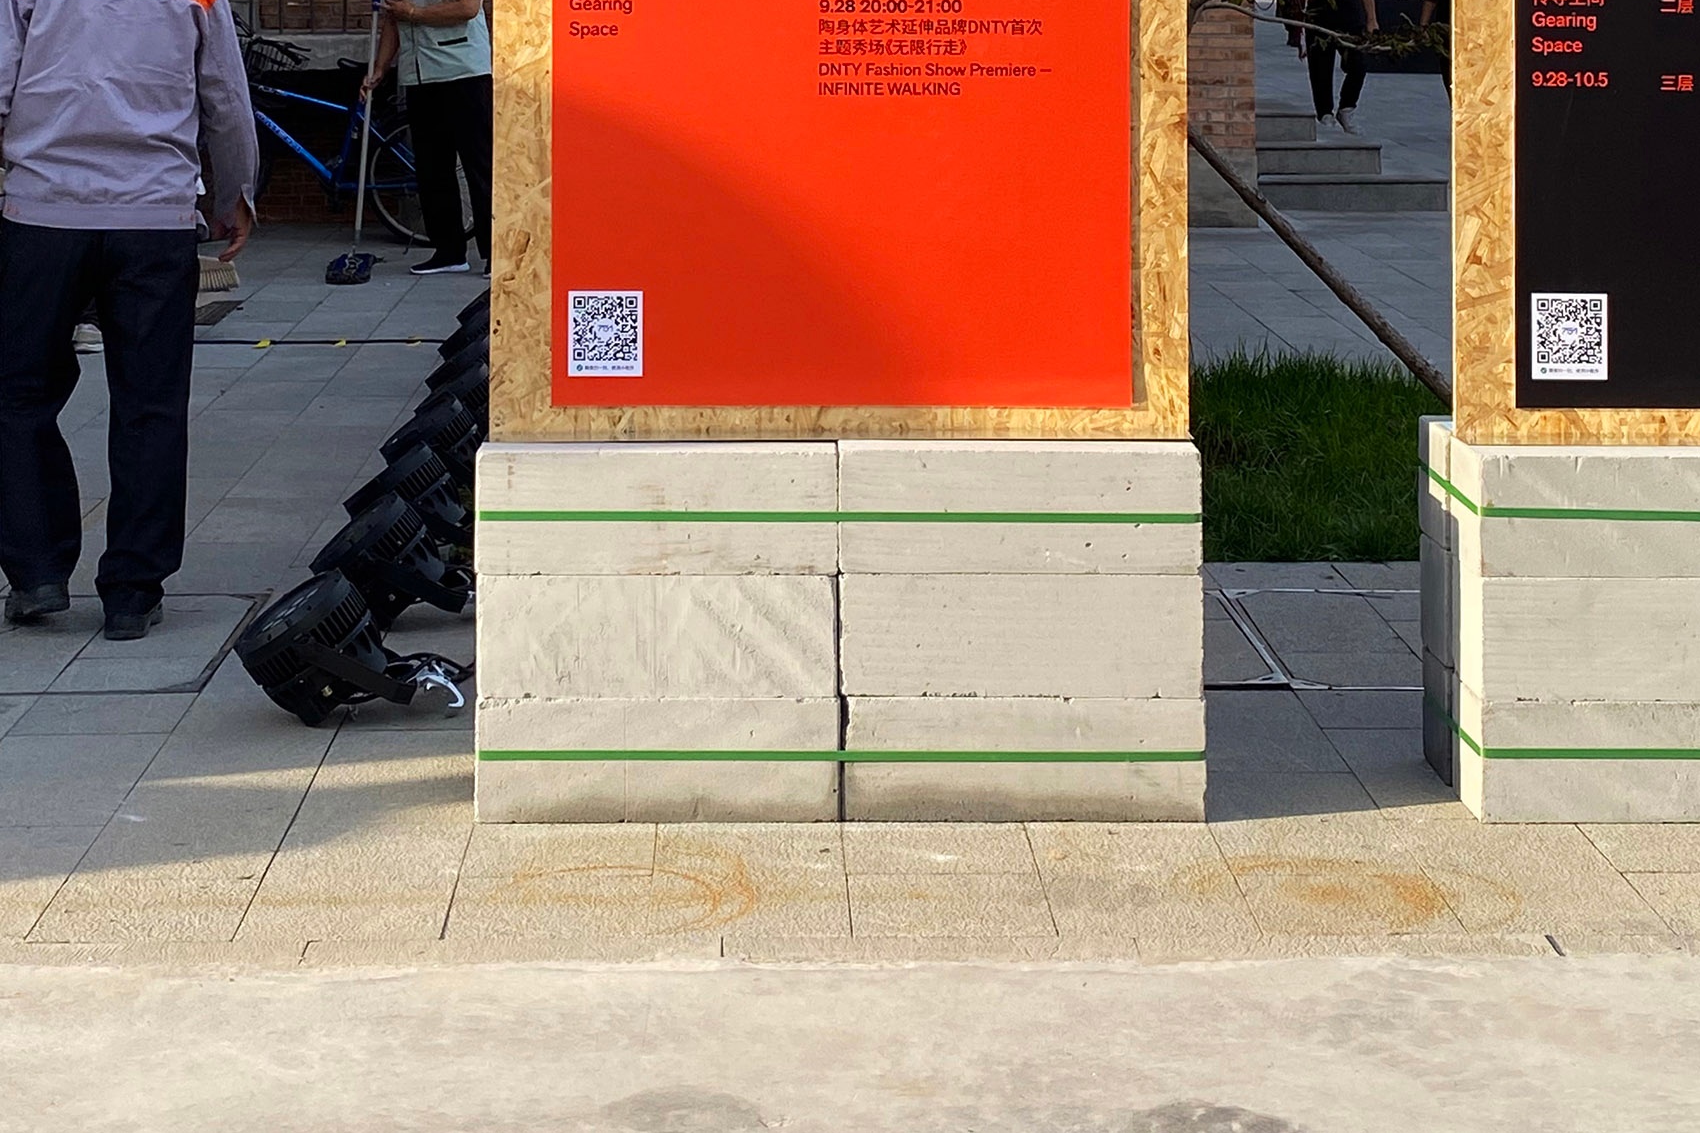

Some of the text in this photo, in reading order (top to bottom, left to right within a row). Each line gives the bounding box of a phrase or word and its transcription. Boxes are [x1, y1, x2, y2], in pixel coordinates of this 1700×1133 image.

[569, 21, 619, 39] Space
[818, 18, 1043, 36] 陶身体艺术延伸品牌DNTY首次
[1531, 11, 1598, 32] Gearing
[818, 38, 968, 56] 主题秀场《无限行走》
[1531, 36, 1583, 56] Space
[818, 62, 862, 76] DNTY
[865, 62, 922, 76] Fashion
[925, 62, 966, 76] Show
[969, 62, 1037, 77] Premiere
[1531, 71, 1609, 87] 9.28-10.5
[1660, 74, 1695, 92] 三层
[818, 82, 961, 96] INFINITE WALKING
